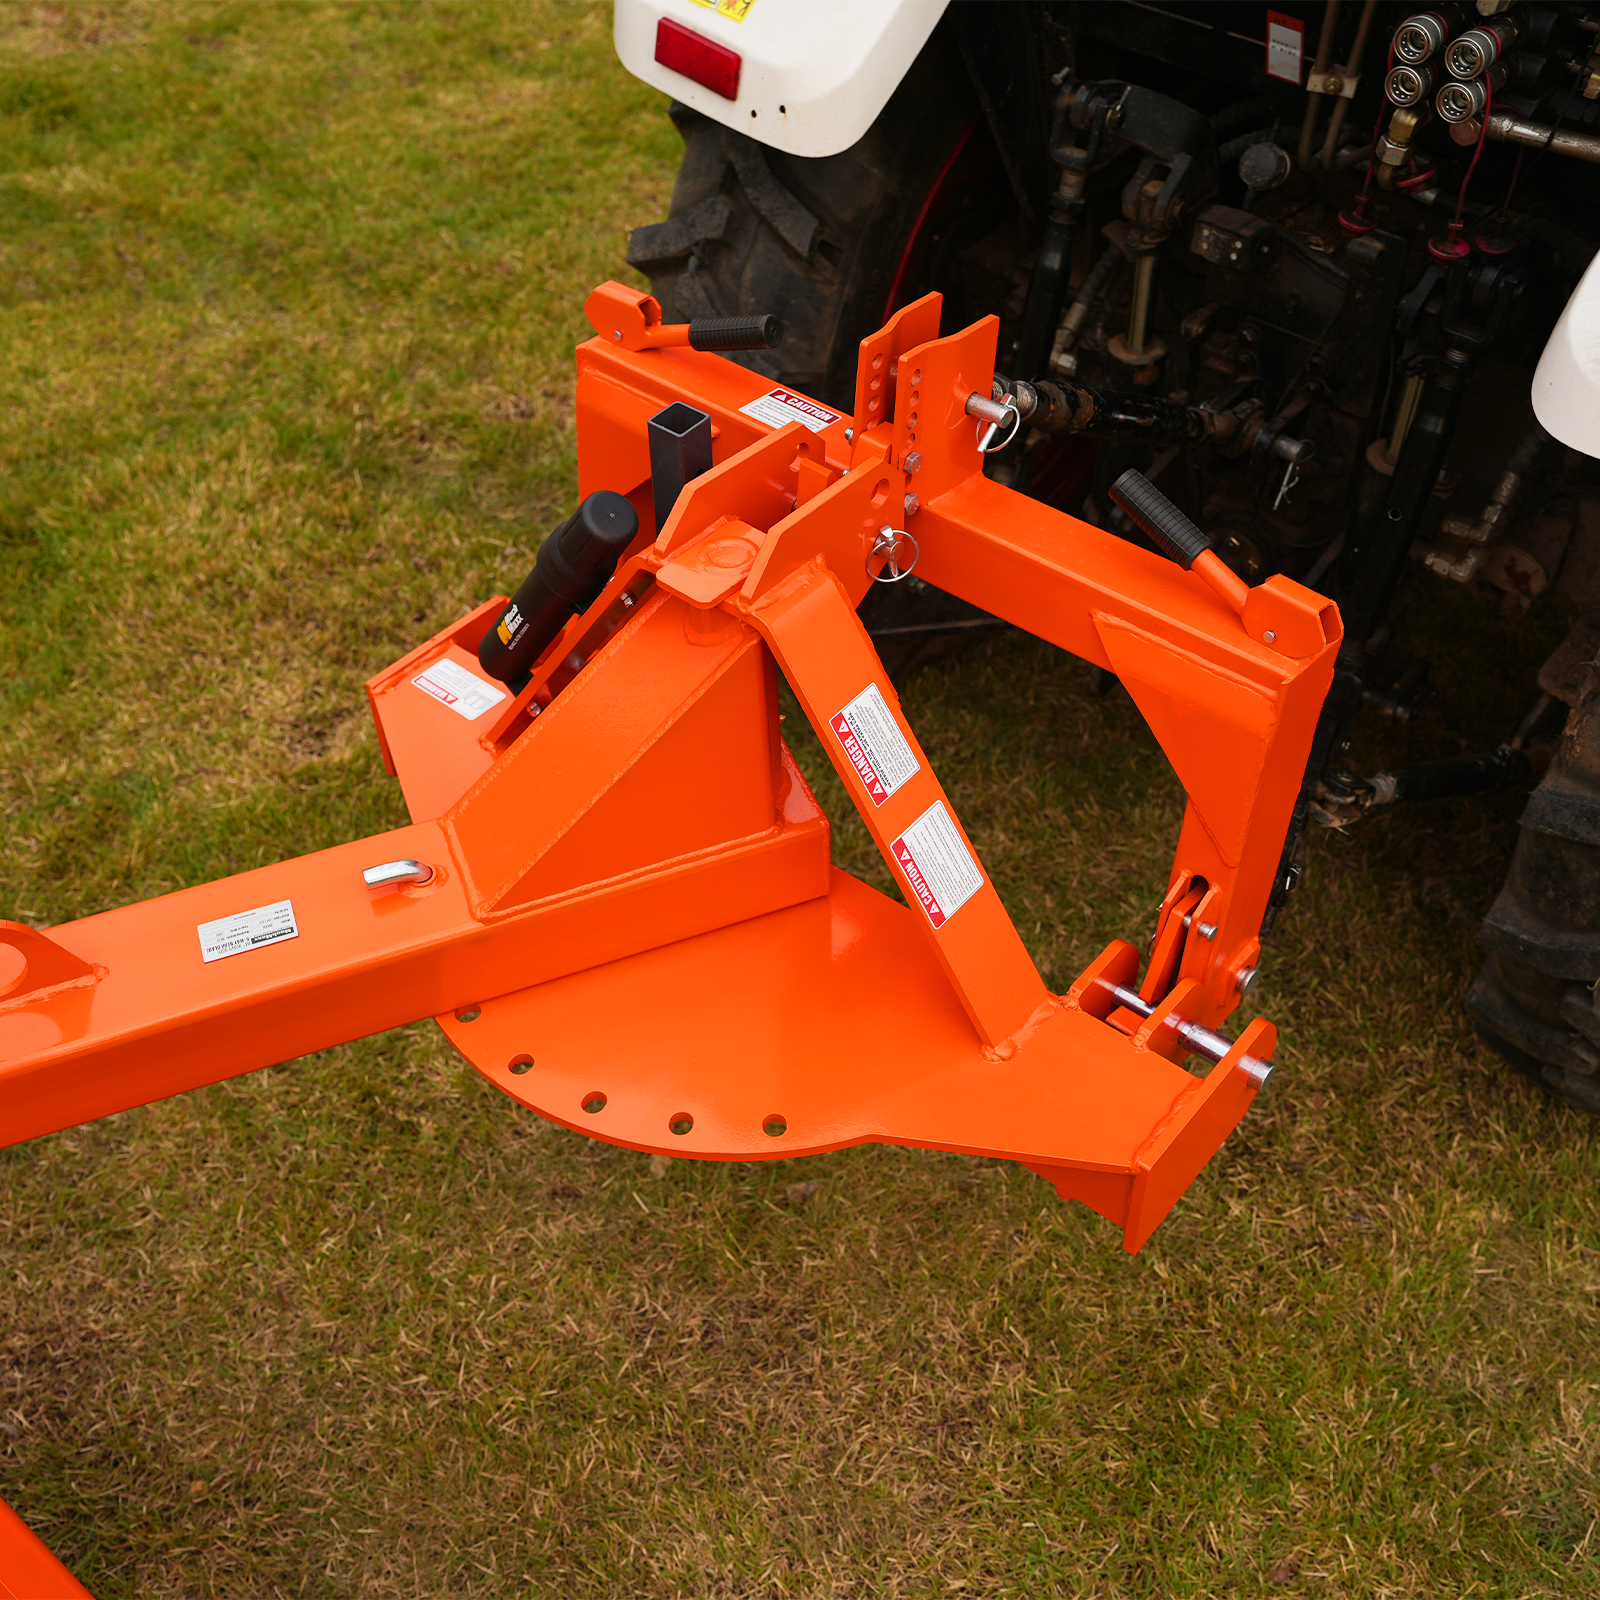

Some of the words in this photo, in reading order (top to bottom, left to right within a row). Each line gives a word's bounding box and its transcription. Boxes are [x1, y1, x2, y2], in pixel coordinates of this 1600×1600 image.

[785, 397, 833, 420] CAUTION
[843, 734, 875, 784] DANGER
[904, 860, 933, 906] CAUTION
